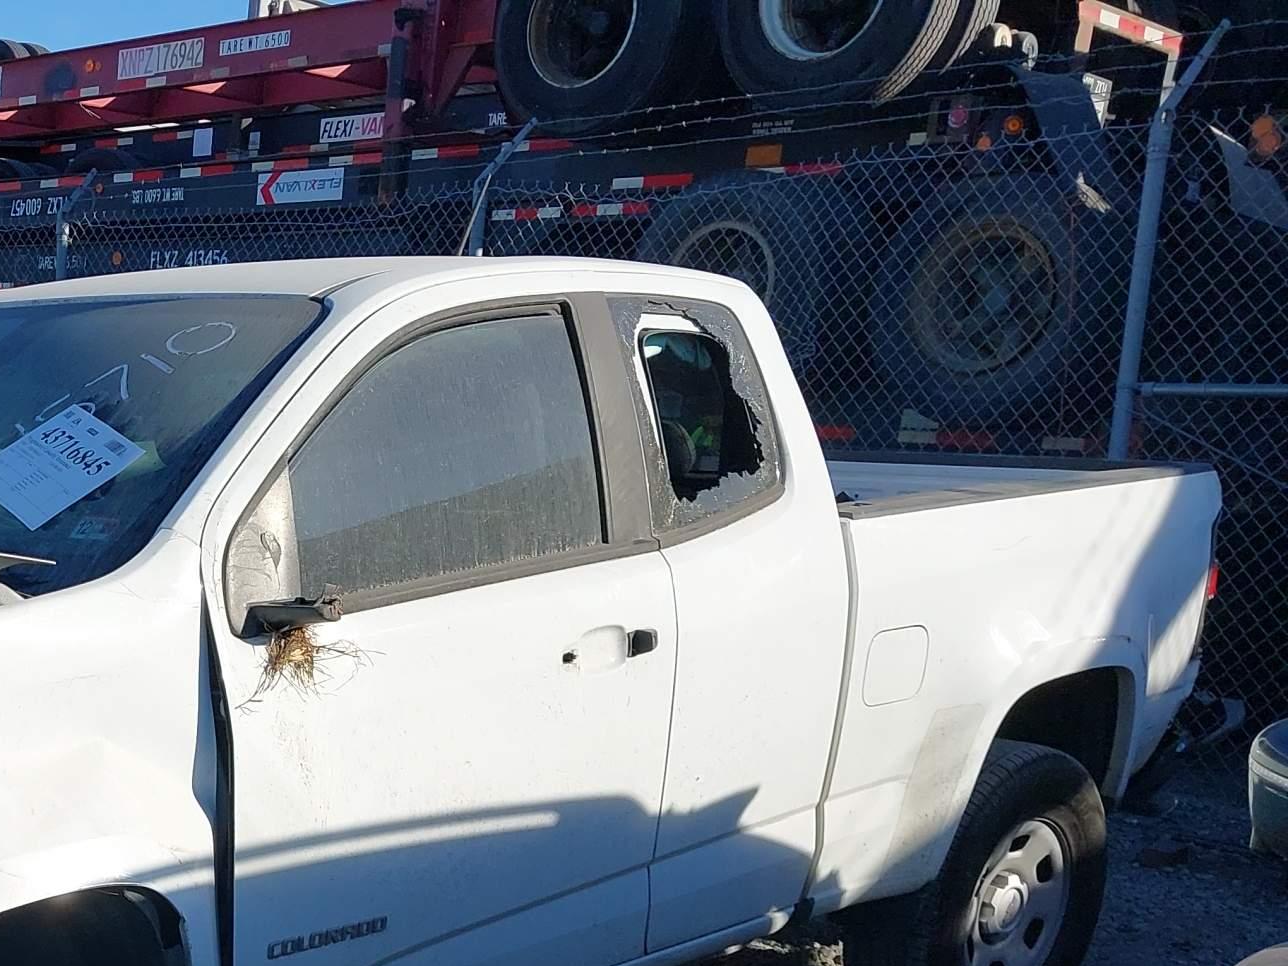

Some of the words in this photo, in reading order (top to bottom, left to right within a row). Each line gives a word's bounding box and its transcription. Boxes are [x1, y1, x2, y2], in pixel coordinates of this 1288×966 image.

[222, 38, 244, 54] TARE
[264, 31, 289, 48] 6500
[488, 112, 507, 126] TARE
[10, 198, 42, 217] 600457
[40, 427, 110, 476] 43716845
[267, 916, 388, 960] COLORADO
